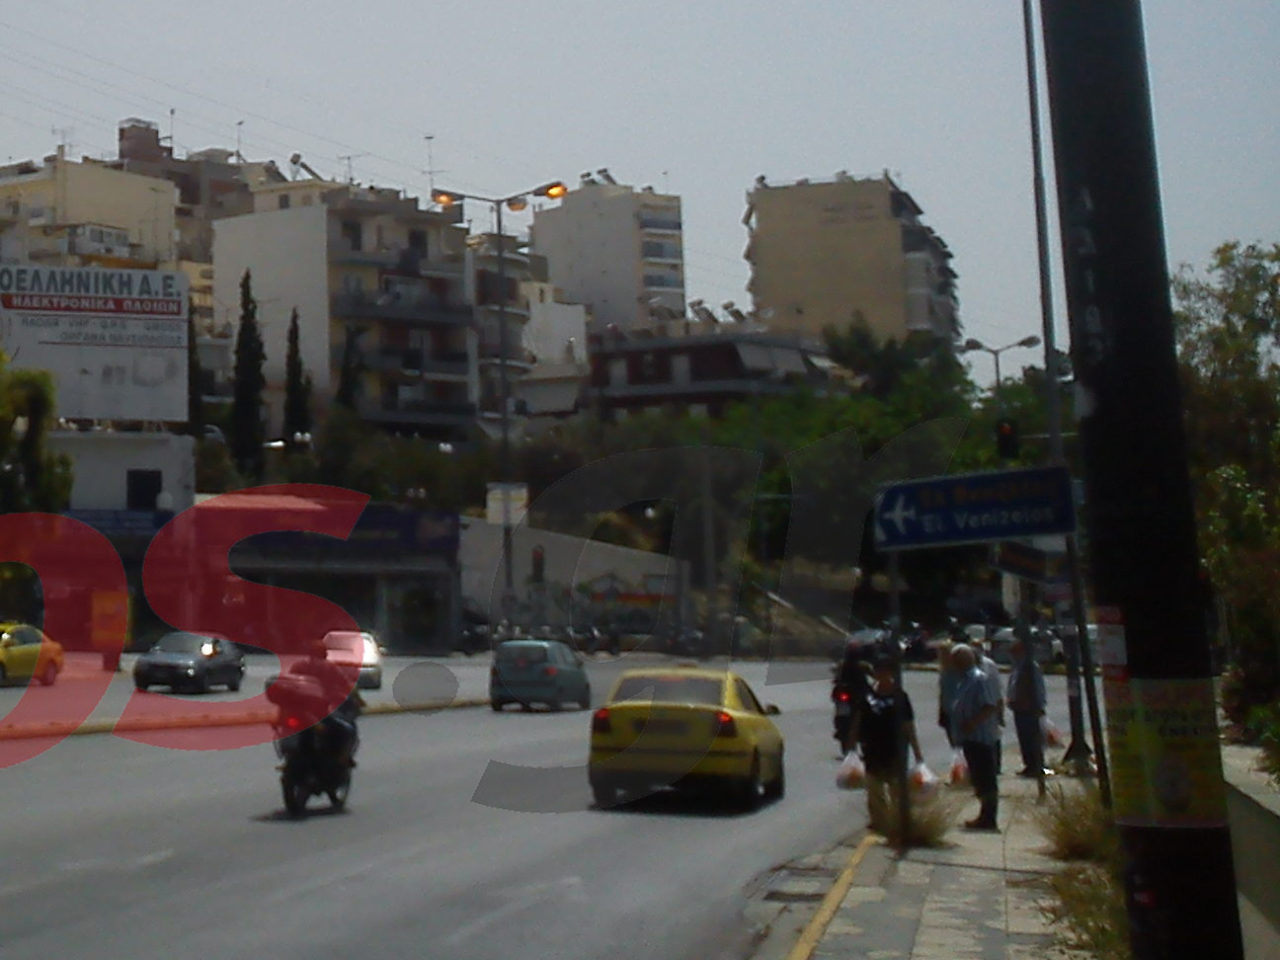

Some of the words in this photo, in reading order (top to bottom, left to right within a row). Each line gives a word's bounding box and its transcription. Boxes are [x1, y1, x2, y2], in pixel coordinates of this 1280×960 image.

[11, 294, 116, 311] ΗΛΕΚΤΡΟΝΙΚΑ
[122, 299, 179, 313] ΠΛΟΙΩΝ
[953, 506, 1054, 528] Venizelos
